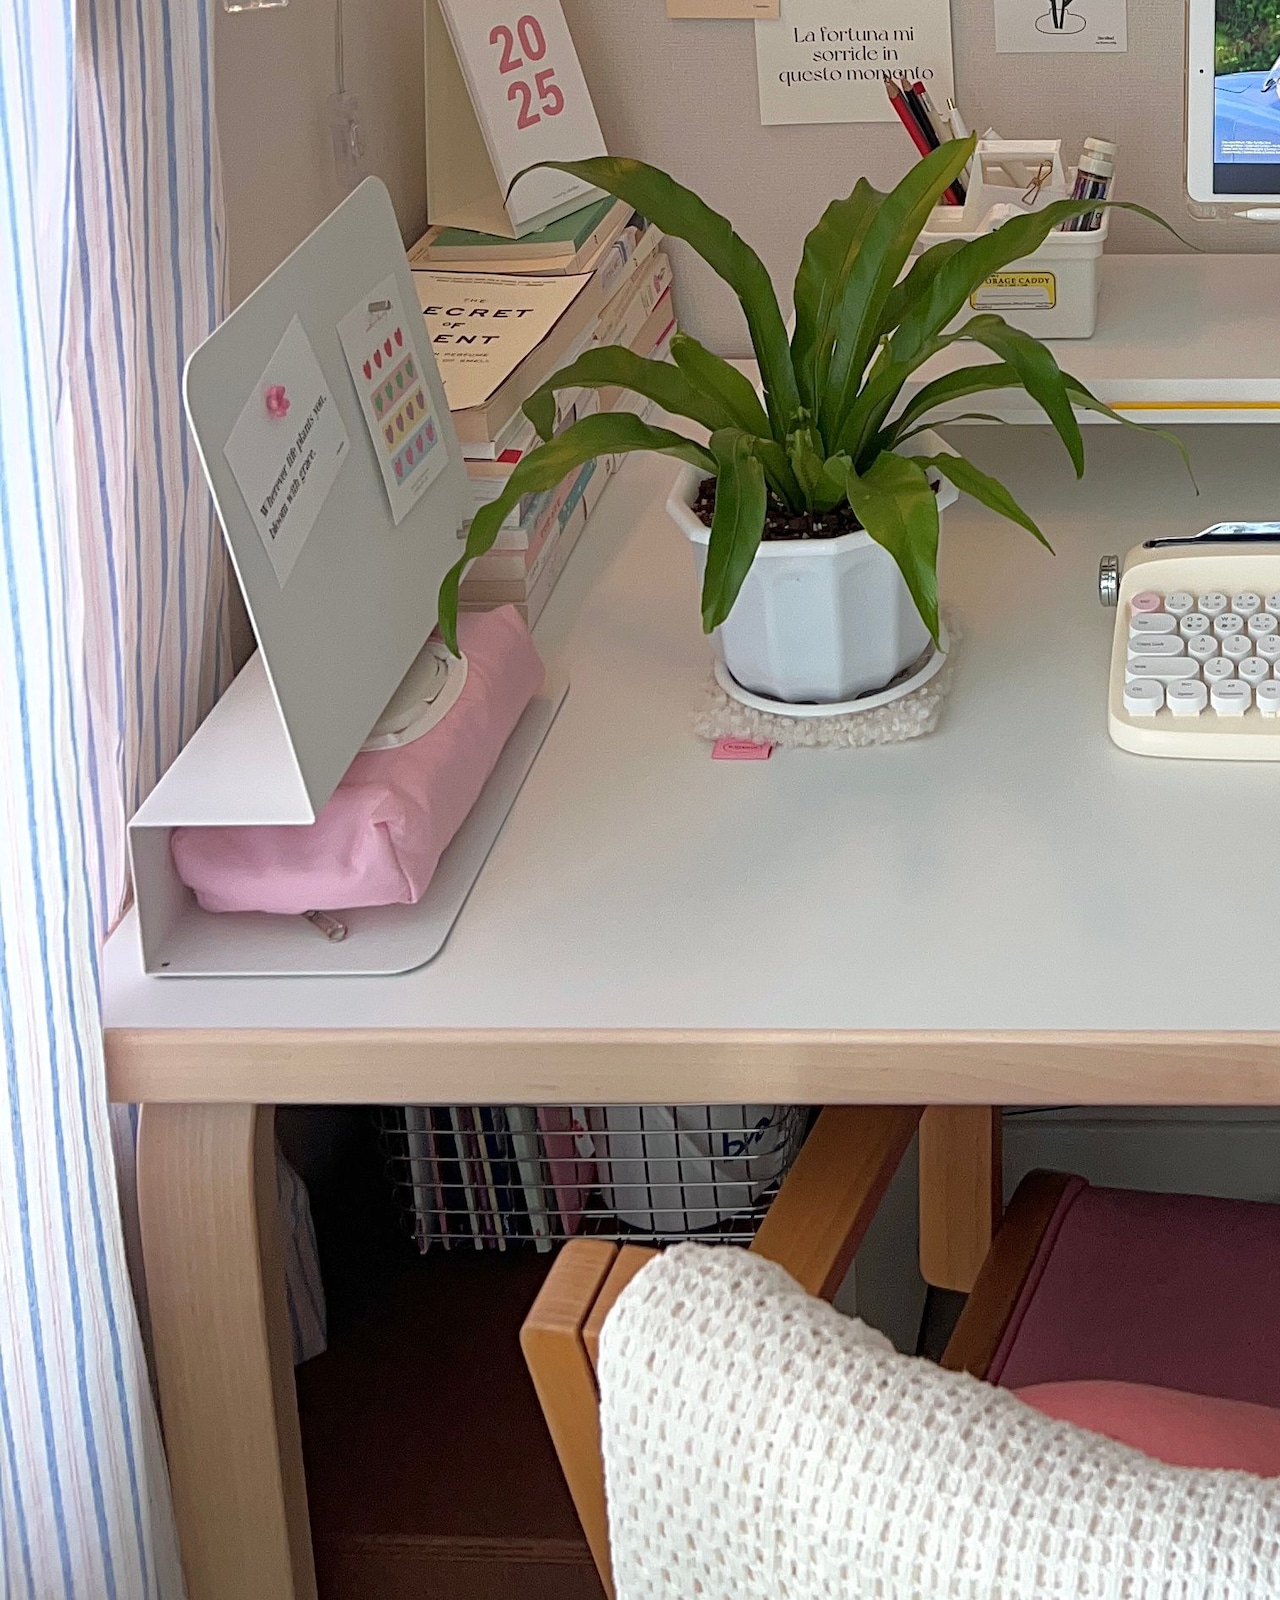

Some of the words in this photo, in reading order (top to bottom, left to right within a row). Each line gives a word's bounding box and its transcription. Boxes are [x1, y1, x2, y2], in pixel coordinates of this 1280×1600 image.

[489, 14, 547, 75] 20
[794, 27, 816, 43] La
[820, 26, 889, 42] fortuna
[894, 27, 914, 41] mi
[813, 46, 879, 62] sorride
[883, 46, 899, 61] in
[779, 67, 842, 86] questo
[847, 66, 934, 80] momento
[507, 68, 564, 130] 25
[422, 306, 534, 318] ECRET
[433, 334, 500, 344] ENT
[260, 464, 288, 518] Wherever
[296, 415, 315, 453] plants
[269, 503, 288, 540] bloom
